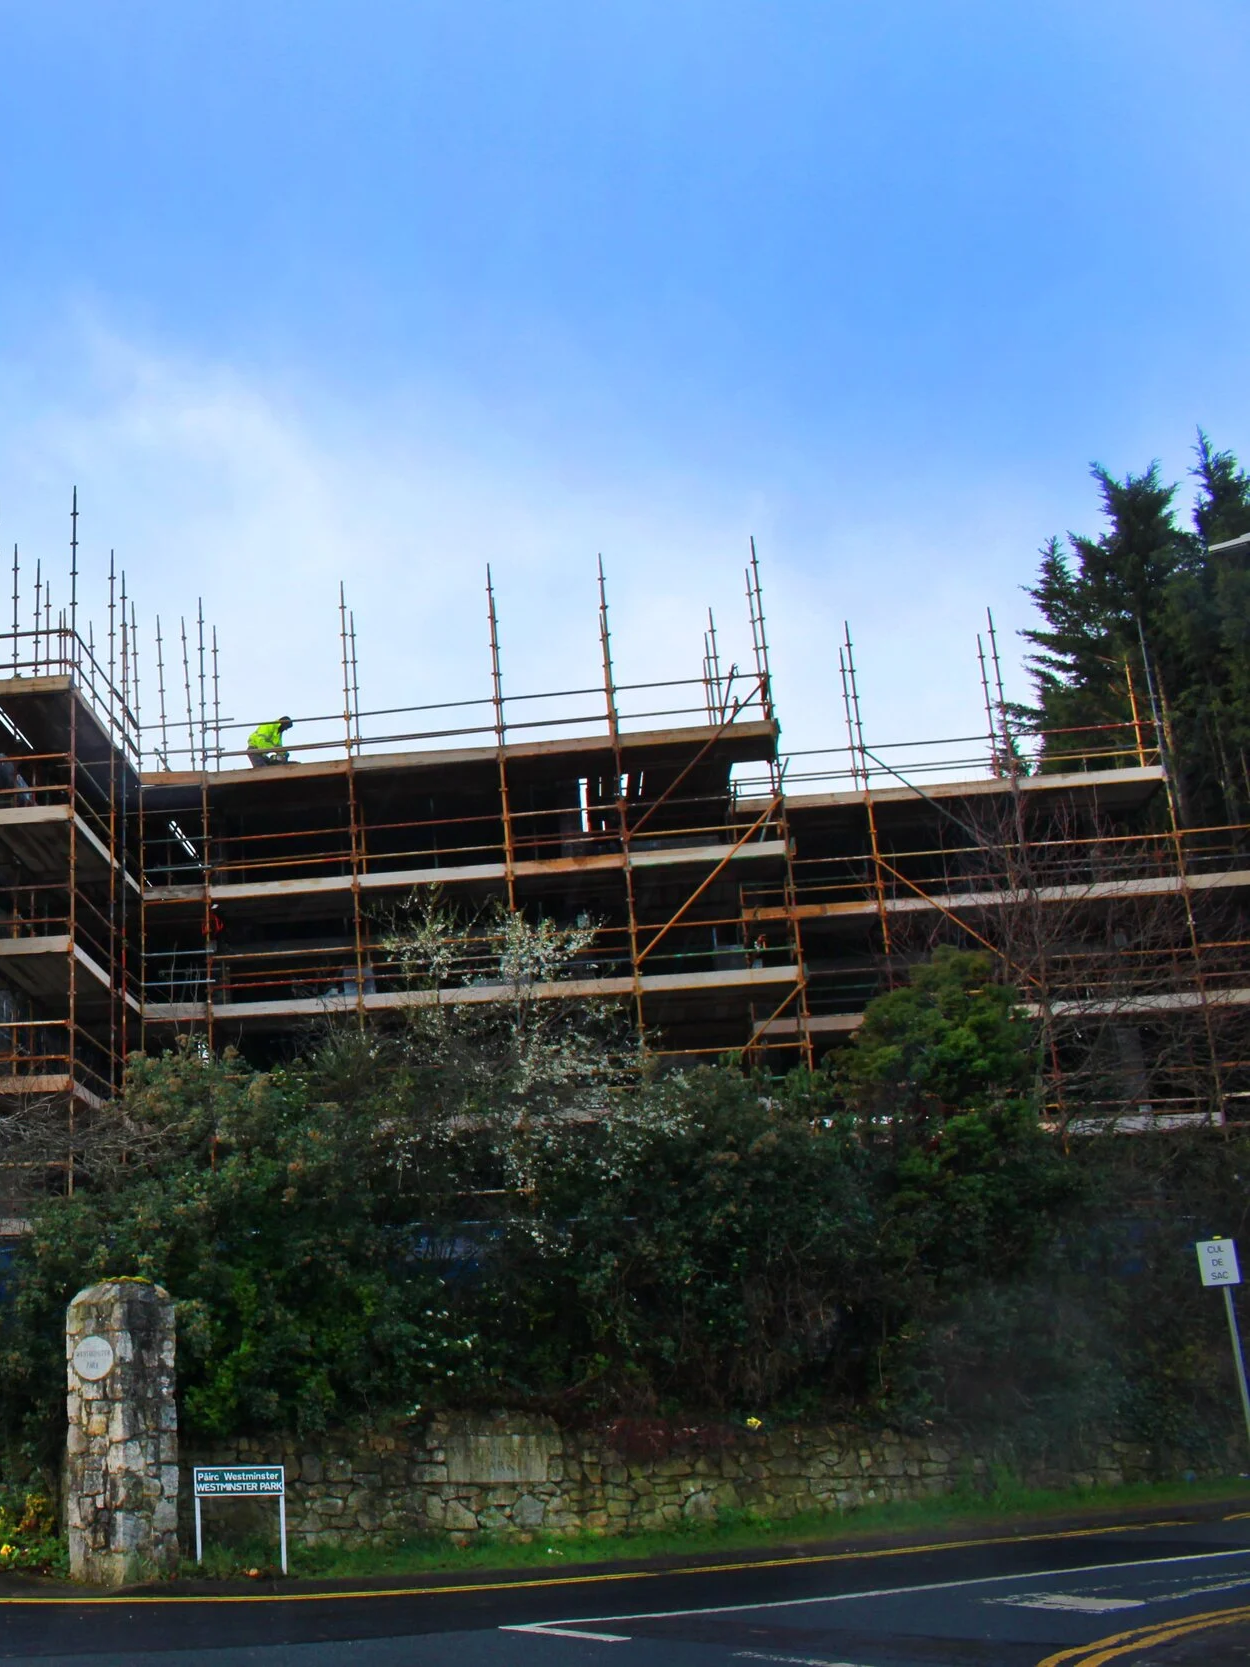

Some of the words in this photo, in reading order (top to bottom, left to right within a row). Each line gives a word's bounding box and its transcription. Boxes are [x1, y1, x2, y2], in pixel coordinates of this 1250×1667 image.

[1206, 1245, 1224, 1254] CUL
[1211, 1258, 1224, 1267] DE
[1210, 1271, 1229, 1281] SAC
[197, 1471, 219, 1481] Páirc
[223, 1471, 279, 1481] Westminster
[196, 1481, 259, 1492] WESTMINSTER
[259, 1481, 283, 1491] PARK
